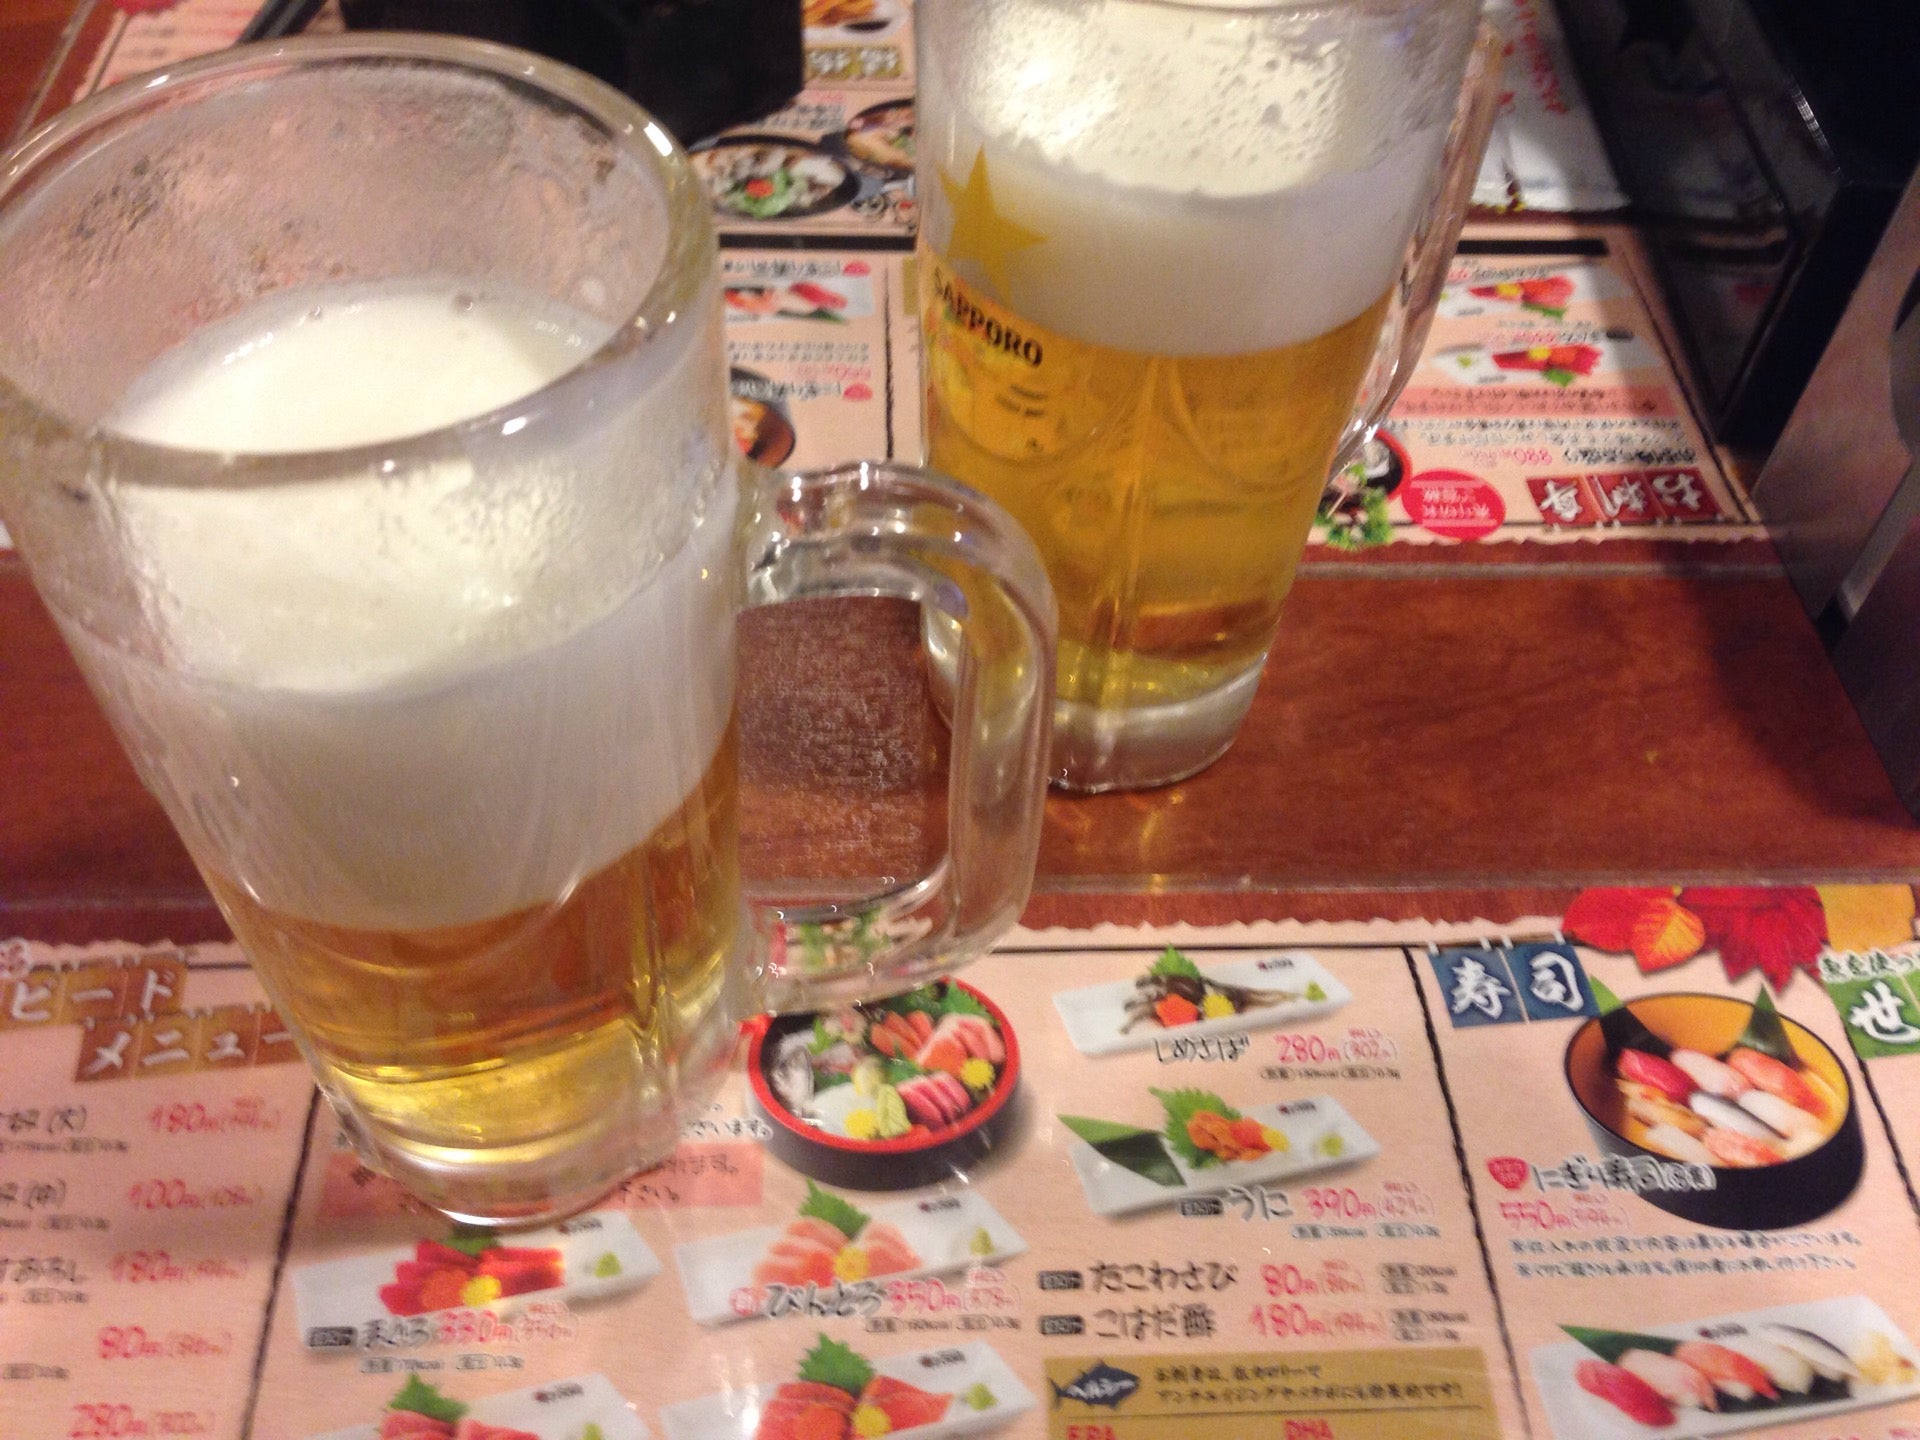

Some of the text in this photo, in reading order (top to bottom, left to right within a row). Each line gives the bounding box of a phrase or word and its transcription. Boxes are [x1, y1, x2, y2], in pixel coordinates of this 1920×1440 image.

[935, 266, 1043, 368] SAPPORO
[1538, 473, 1702, 521] お刺身
[1450, 951, 1584, 1019] 寿司
[1153, 1035, 1250, 1063] しめさば
[1227, 1183, 1295, 1221] うに
[1089, 1259, 1239, 1293] たこわさび
